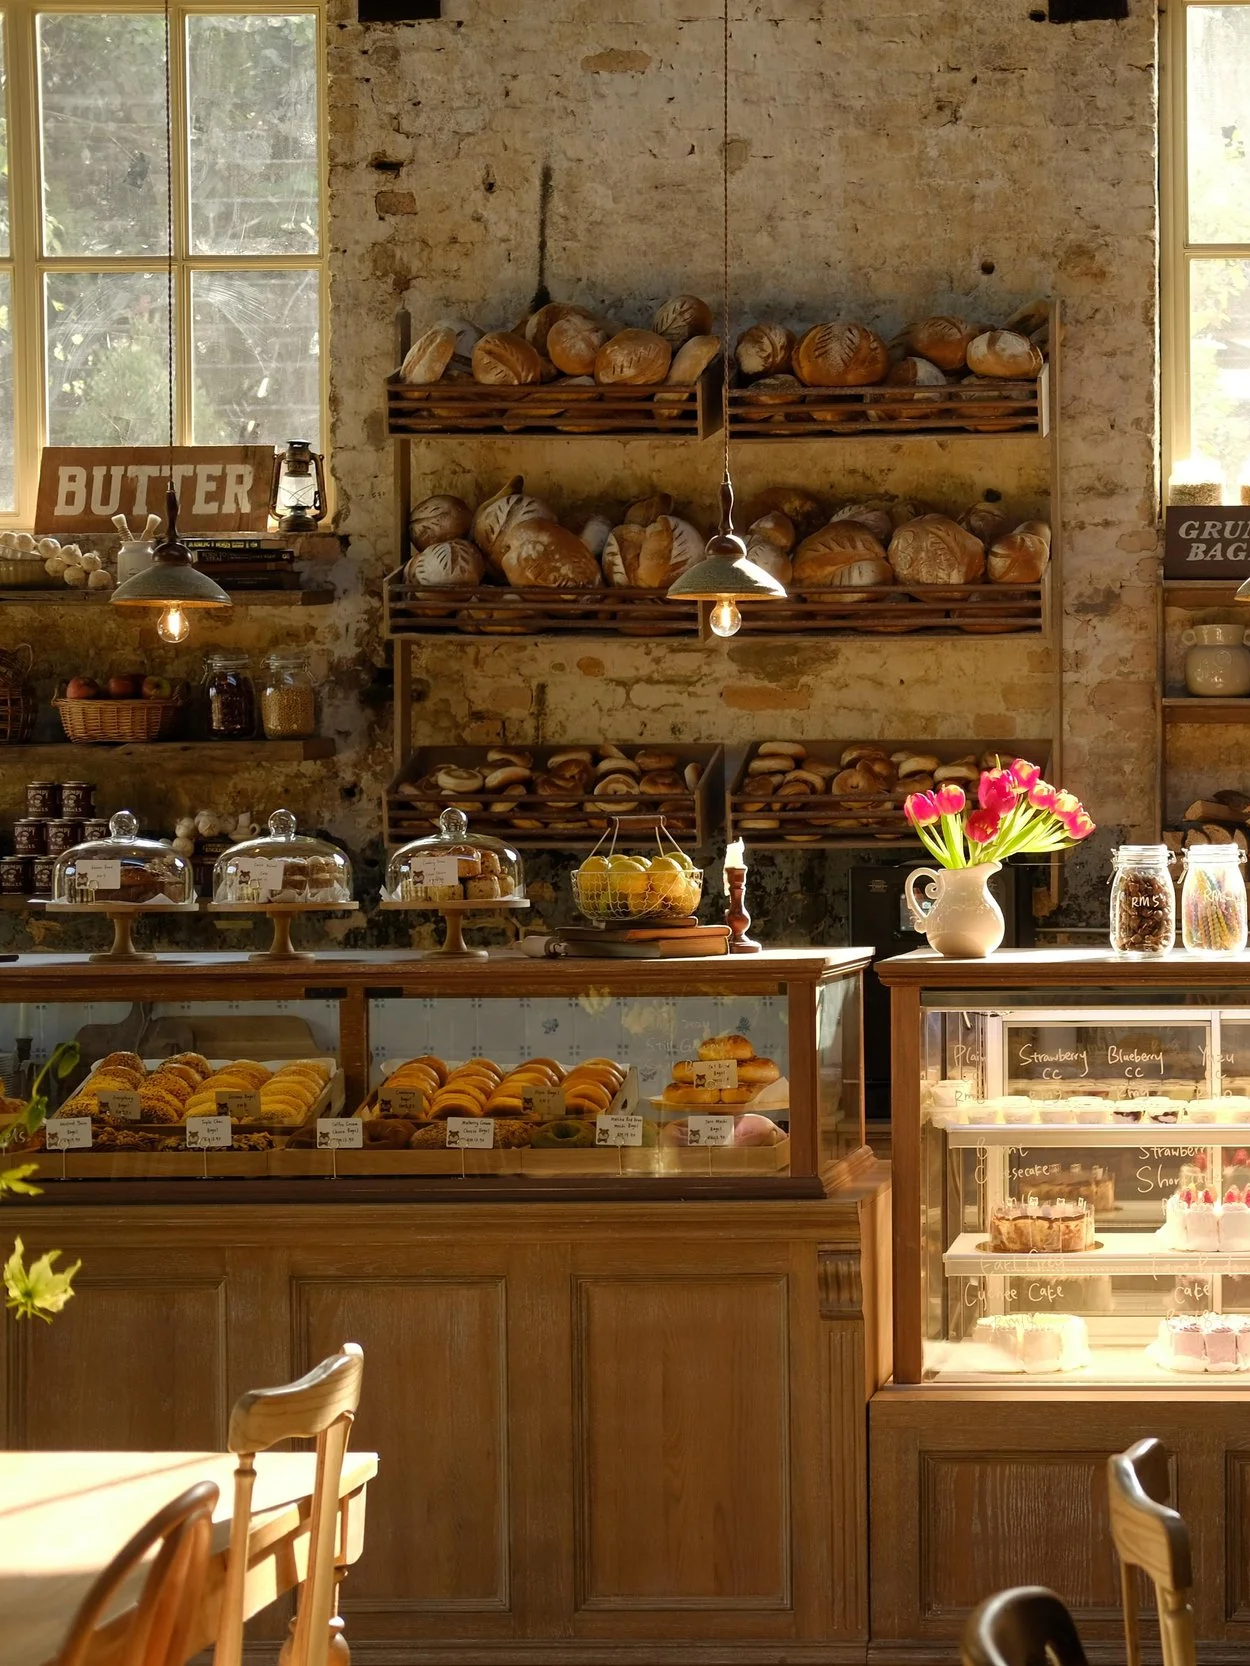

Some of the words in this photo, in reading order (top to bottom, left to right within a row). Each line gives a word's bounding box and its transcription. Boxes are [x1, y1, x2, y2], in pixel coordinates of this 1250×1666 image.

[53, 464, 254, 517] BUTTER
[953, 1044, 987, 1067] Plain
[1018, 1043, 1090, 1079] Strawberry
[1107, 1044, 1165, 1076] Blueberry
[1042, 1068, 1063, 1080] CC
[1124, 1067, 1145, 1078] CC
[1028, 1282, 1064, 1303] Cake
[1174, 1283, 1211, 1305] Cake
